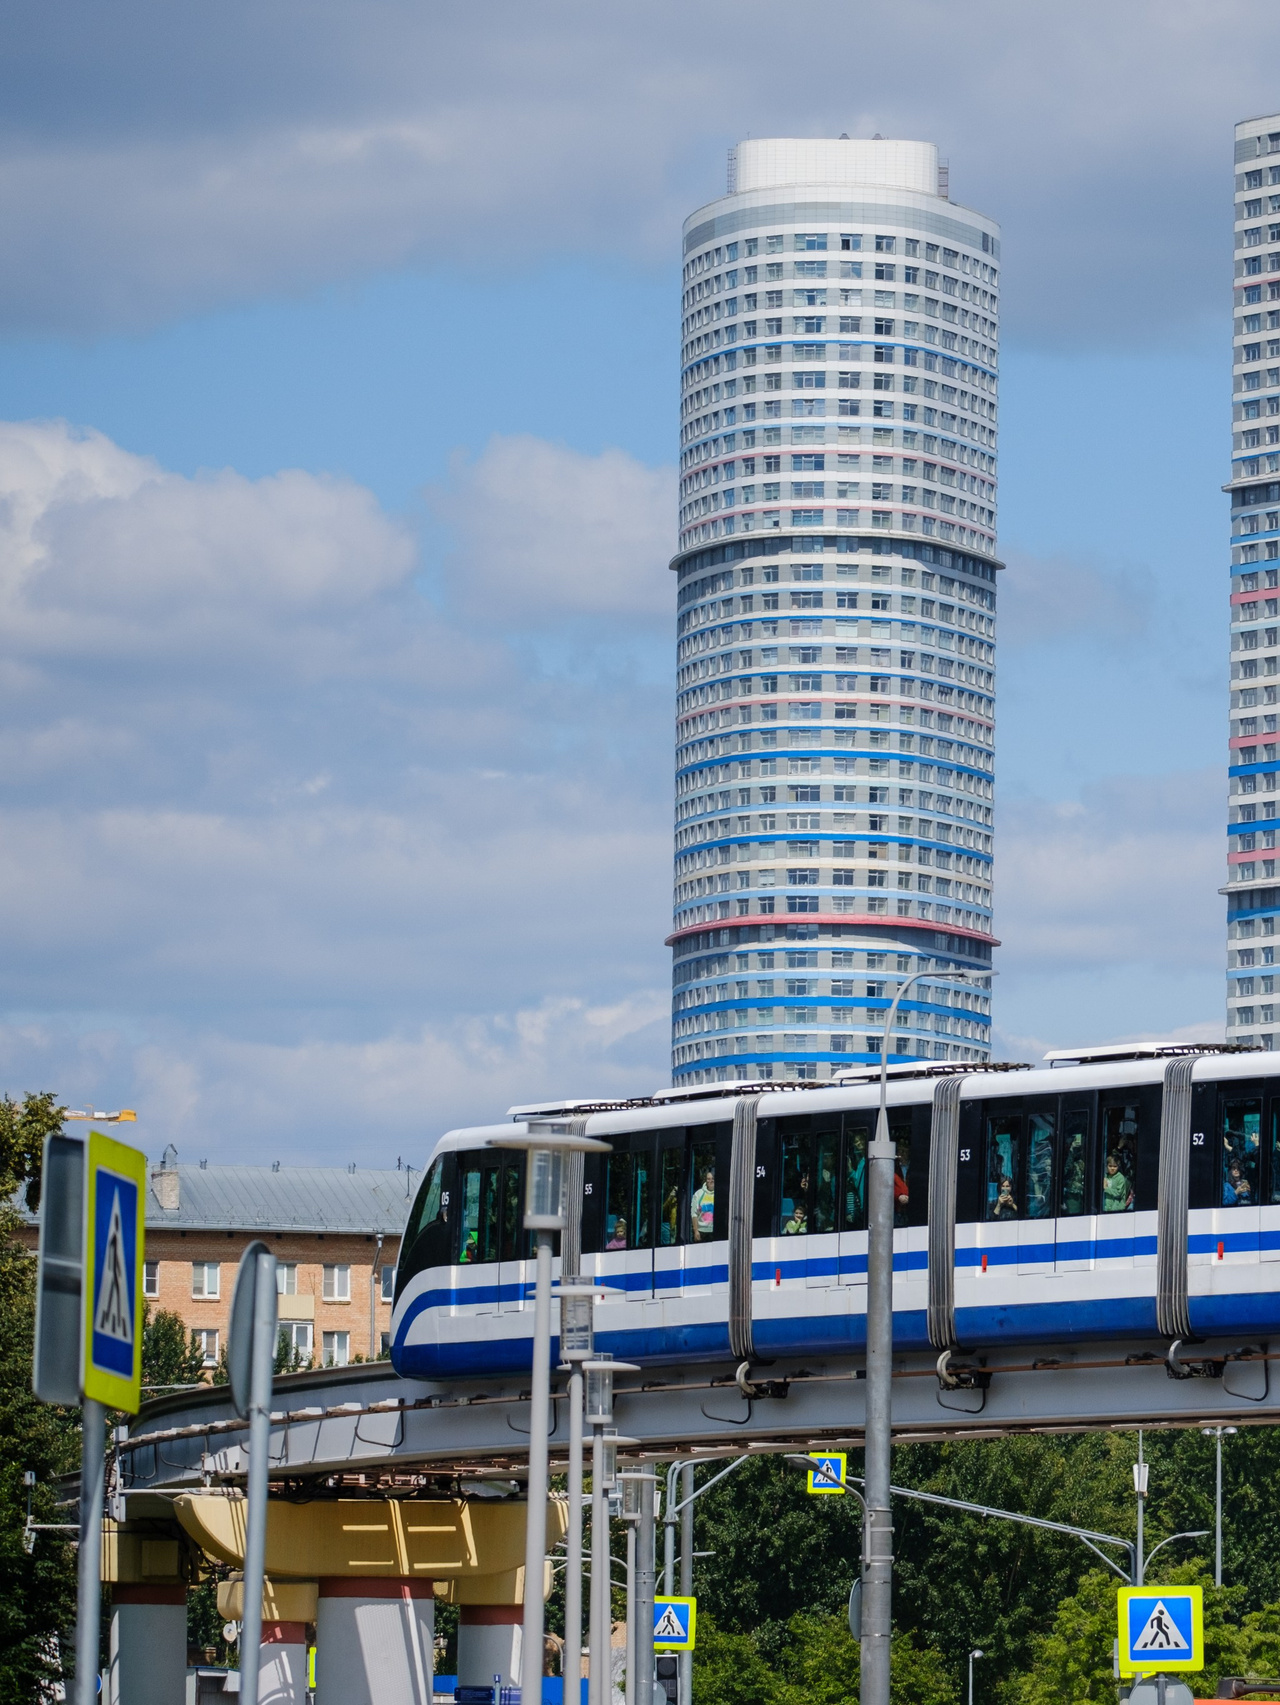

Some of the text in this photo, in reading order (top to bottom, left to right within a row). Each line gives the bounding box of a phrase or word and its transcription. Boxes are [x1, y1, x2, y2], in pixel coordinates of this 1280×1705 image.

[1192, 1132, 1204, 1145] 52
[960, 1149, 971, 1161] 53
[756, 1165, 766, 1178] 54
[585, 1183, 593, 1195] 55
[441, 1191, 450, 1205] 05
